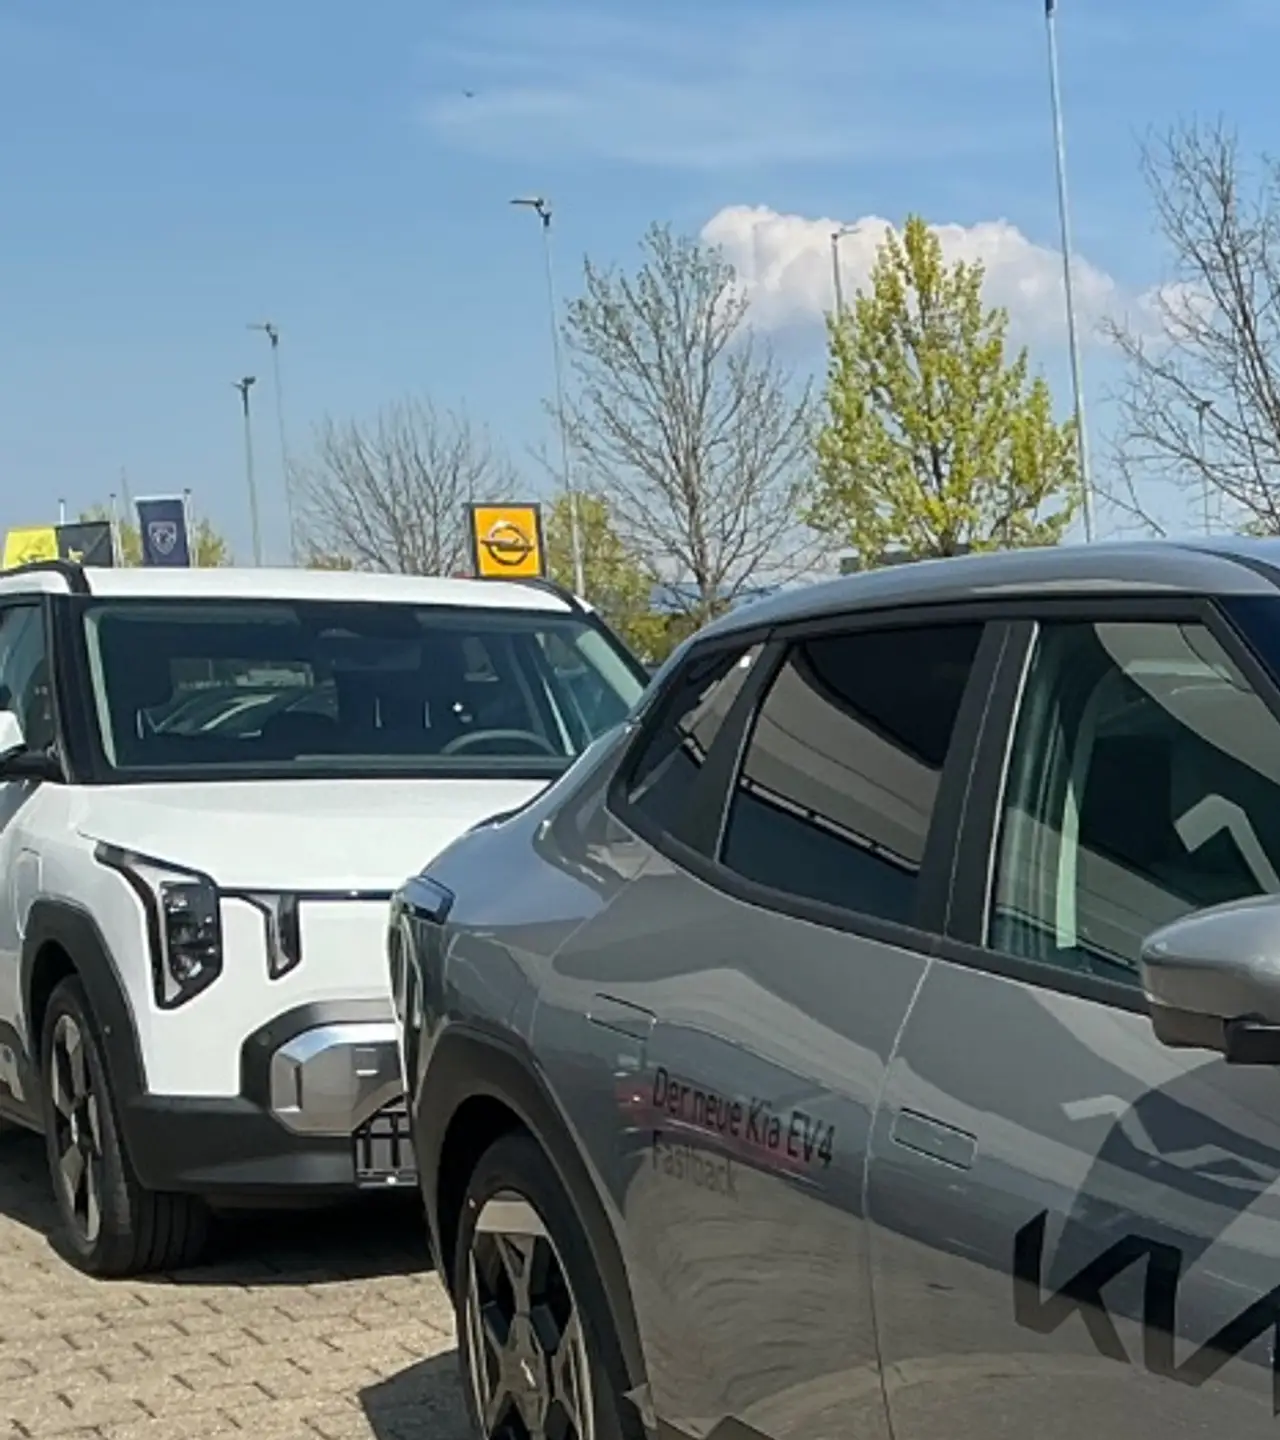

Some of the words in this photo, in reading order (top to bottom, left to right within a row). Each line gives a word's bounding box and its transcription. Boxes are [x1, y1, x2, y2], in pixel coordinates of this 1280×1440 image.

[652, 1065, 691, 1117] Der
[692, 1090, 743, 1138] neue
[744, 1097, 782, 1150] Kia
[785, 1108, 837, 1169] EV4
[651, 1128, 740, 1202] Fastback
